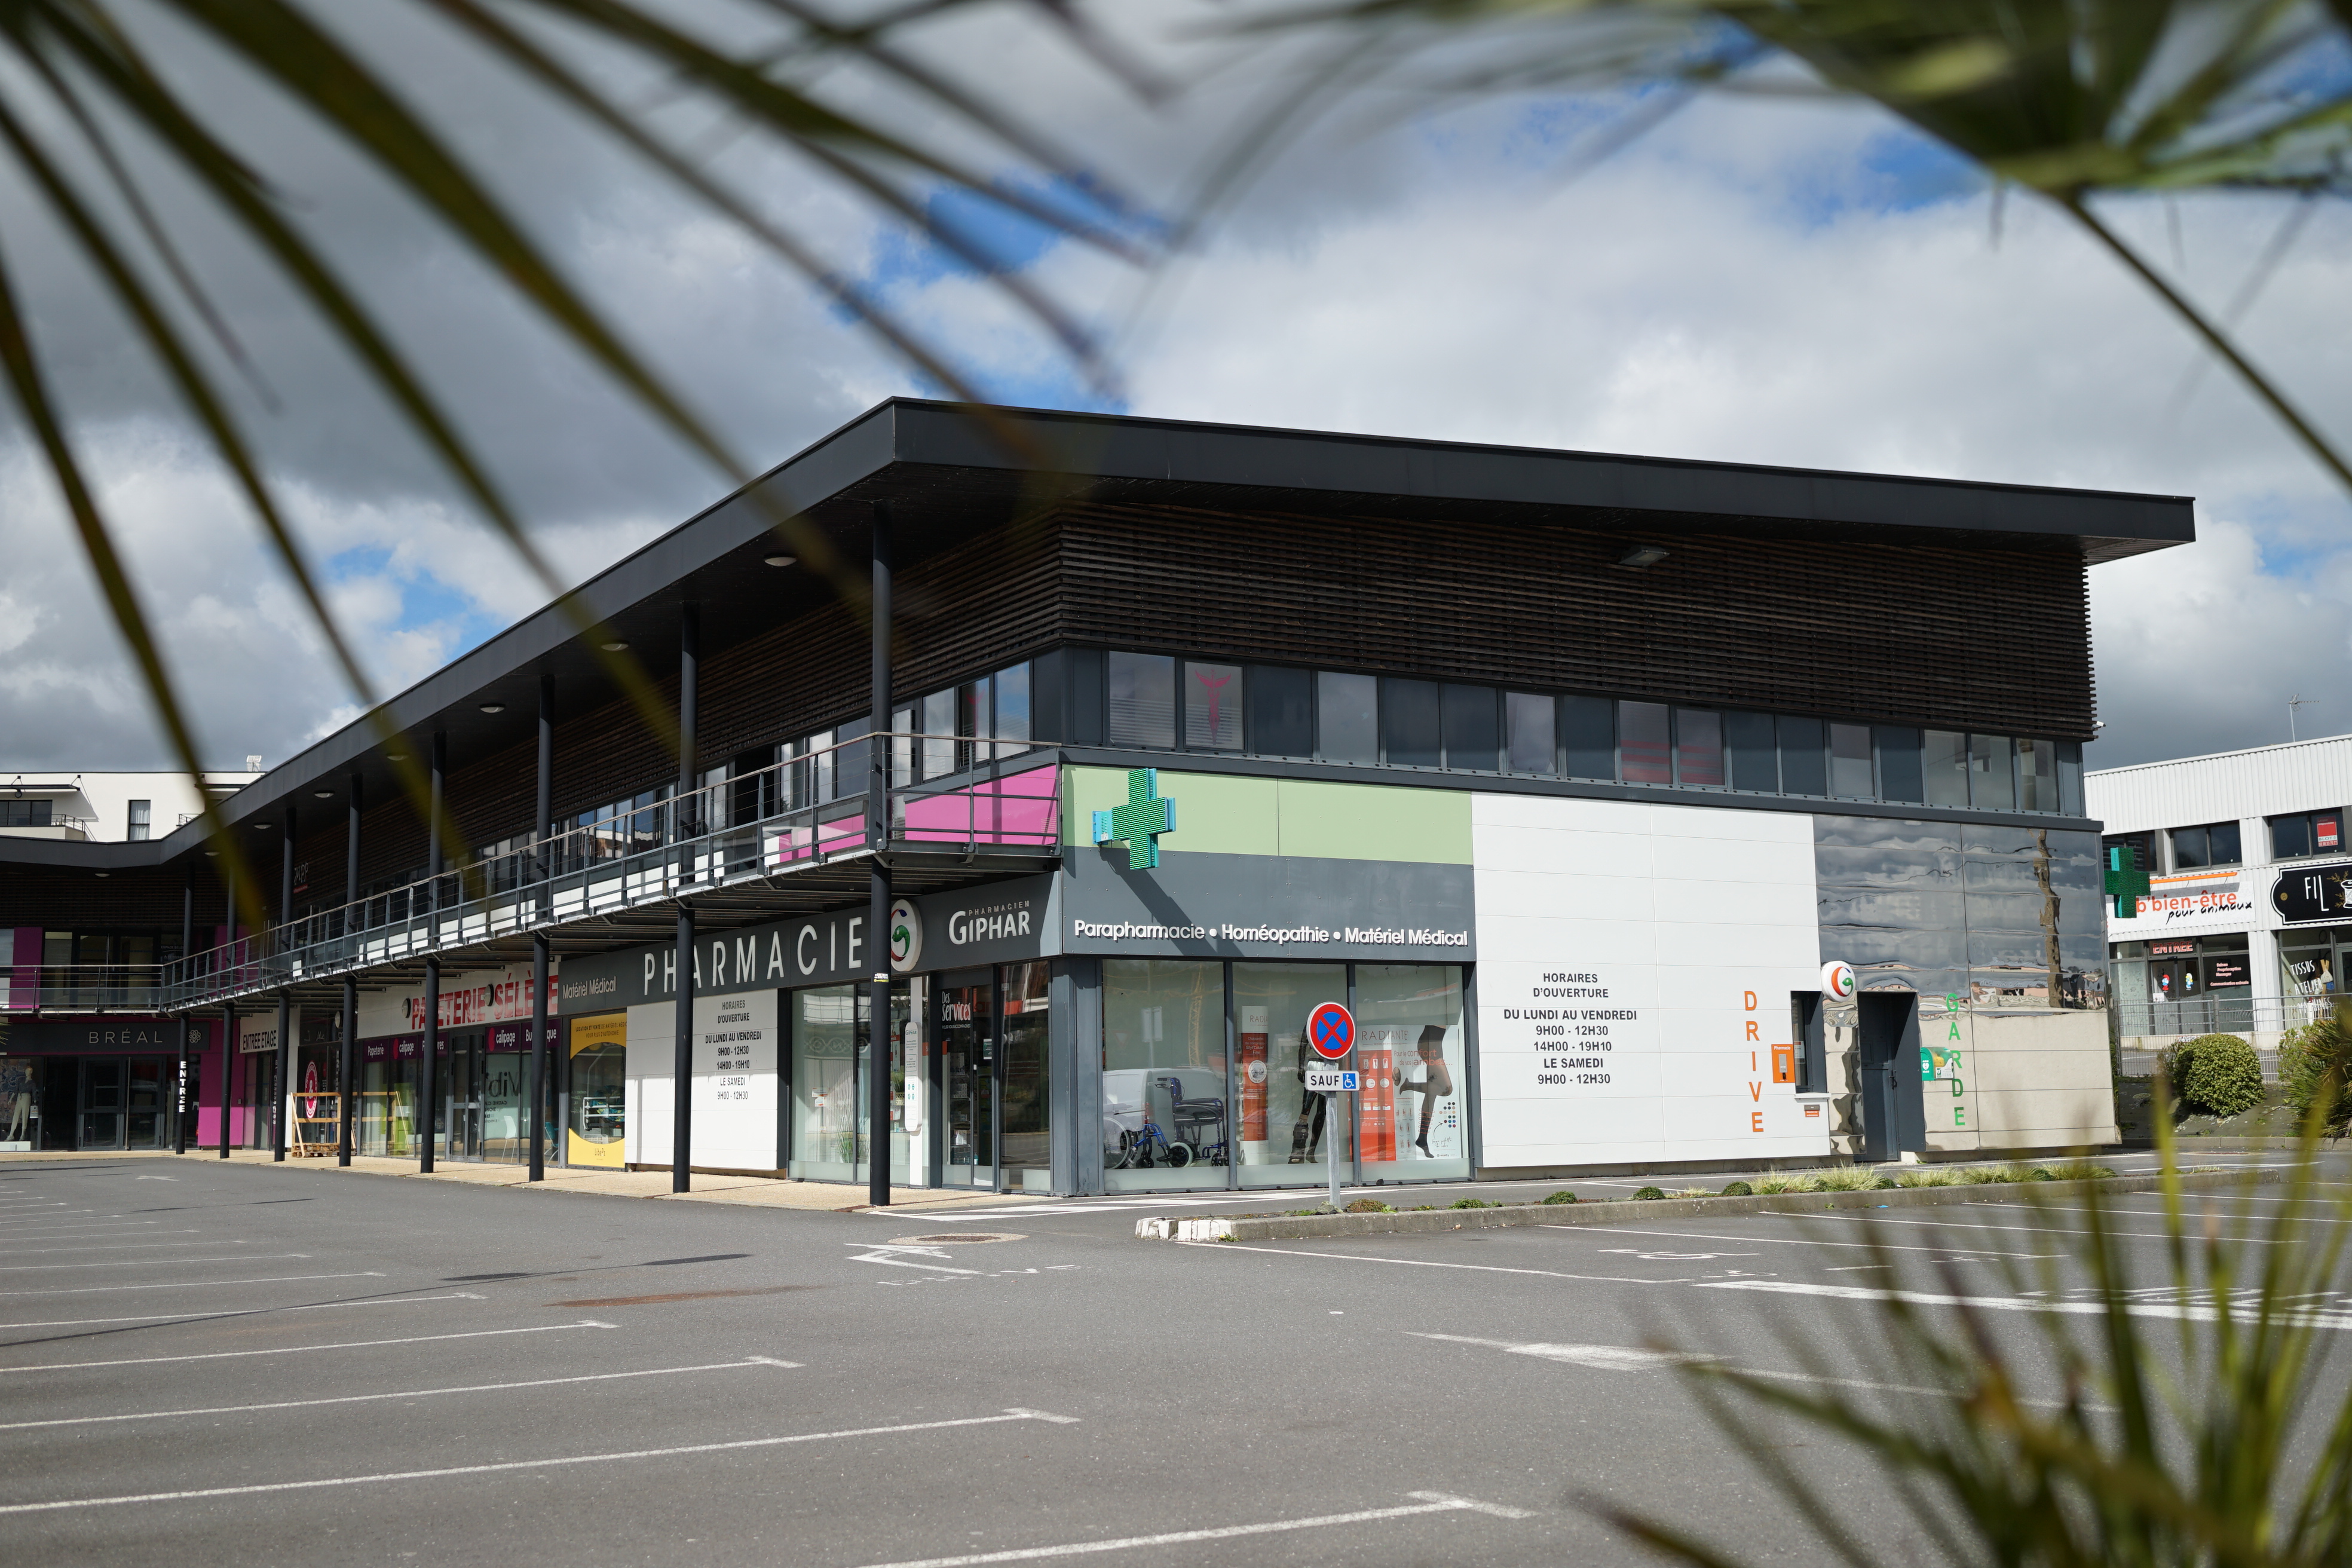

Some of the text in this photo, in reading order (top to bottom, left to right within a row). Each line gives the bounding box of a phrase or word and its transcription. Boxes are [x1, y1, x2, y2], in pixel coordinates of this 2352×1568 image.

[2304, 874, 2329, 912] FIL
[969, 900, 1030, 916] PHARMACIEN
[2166, 901, 2252, 925] pour animaux
[949, 910, 1030, 945] GIPHAR
[1075, 920, 1468, 945] Parapharmacie Homéopathie Matériel Médical
[2153, 941, 2193, 954] ENTREE
[644, 917, 862, 996] PHARMACIE
[2290, 960, 2315, 975] TISSUS
[1544, 973, 1598, 983] HORAIRES
[563, 976, 616, 999] Matériel Médical
[1533, 988, 1609, 998] D'OUVERTURE
[2295, 978, 2323, 995] ATELIER
[412, 970, 558, 1030] PAETERIE SÉLÈE
[942, 991, 950, 1004] Des
[722, 1000, 745, 1010] HORAIRES
[942, 1002, 971, 1021] services
[718, 1013, 750, 1024] D'OUVERTURE
[1503, 1009, 1637, 1020] DU LUNDI AU VENDREDI
[89, 1028, 163, 1044] BRÉAL
[705, 1031, 762, 1043] DU LUNDI AU VENDREDI
[1361, 1030, 1409, 1040] RADIANTE
[1536, 1025, 1564, 1036] 9H00
[1575, 1025, 1608, 1036] 12H30
[243, 1032, 260, 1051] ENTREE
[261, 1030, 277, 1048] ETAGE
[496, 1029, 516, 1048] calipage
[368, 1043, 384, 1058] Papeterie
[399, 1040, 414, 1055] calipage
[718, 1047, 730, 1056] 9H00
[734, 1046, 749, 1055] 12H30
[1407, 1049, 1437, 1057] confort
[1534, 1042, 1568, 1051] 14H00
[1579, 1042, 1612, 1051] 19H10
[717, 1061, 731, 1070] 14H00
[736, 1059, 750, 1069] 19H10
[1544, 1058, 1603, 1068] LE SAMEDI
[1744, 991, 1764, 1132] DRIVE
[1946, 993, 1965, 1126] GARDE
[720, 1077, 746, 1086] LE SAMEDI
[1310, 1075, 1340, 1086] SAUF
[1538, 1074, 1566, 1085] 9H00
[1576, 1074, 1610, 1084] 12H30
[717, 1091, 729, 1100] 9H00
[734, 1091, 748, 1100] 12H30
